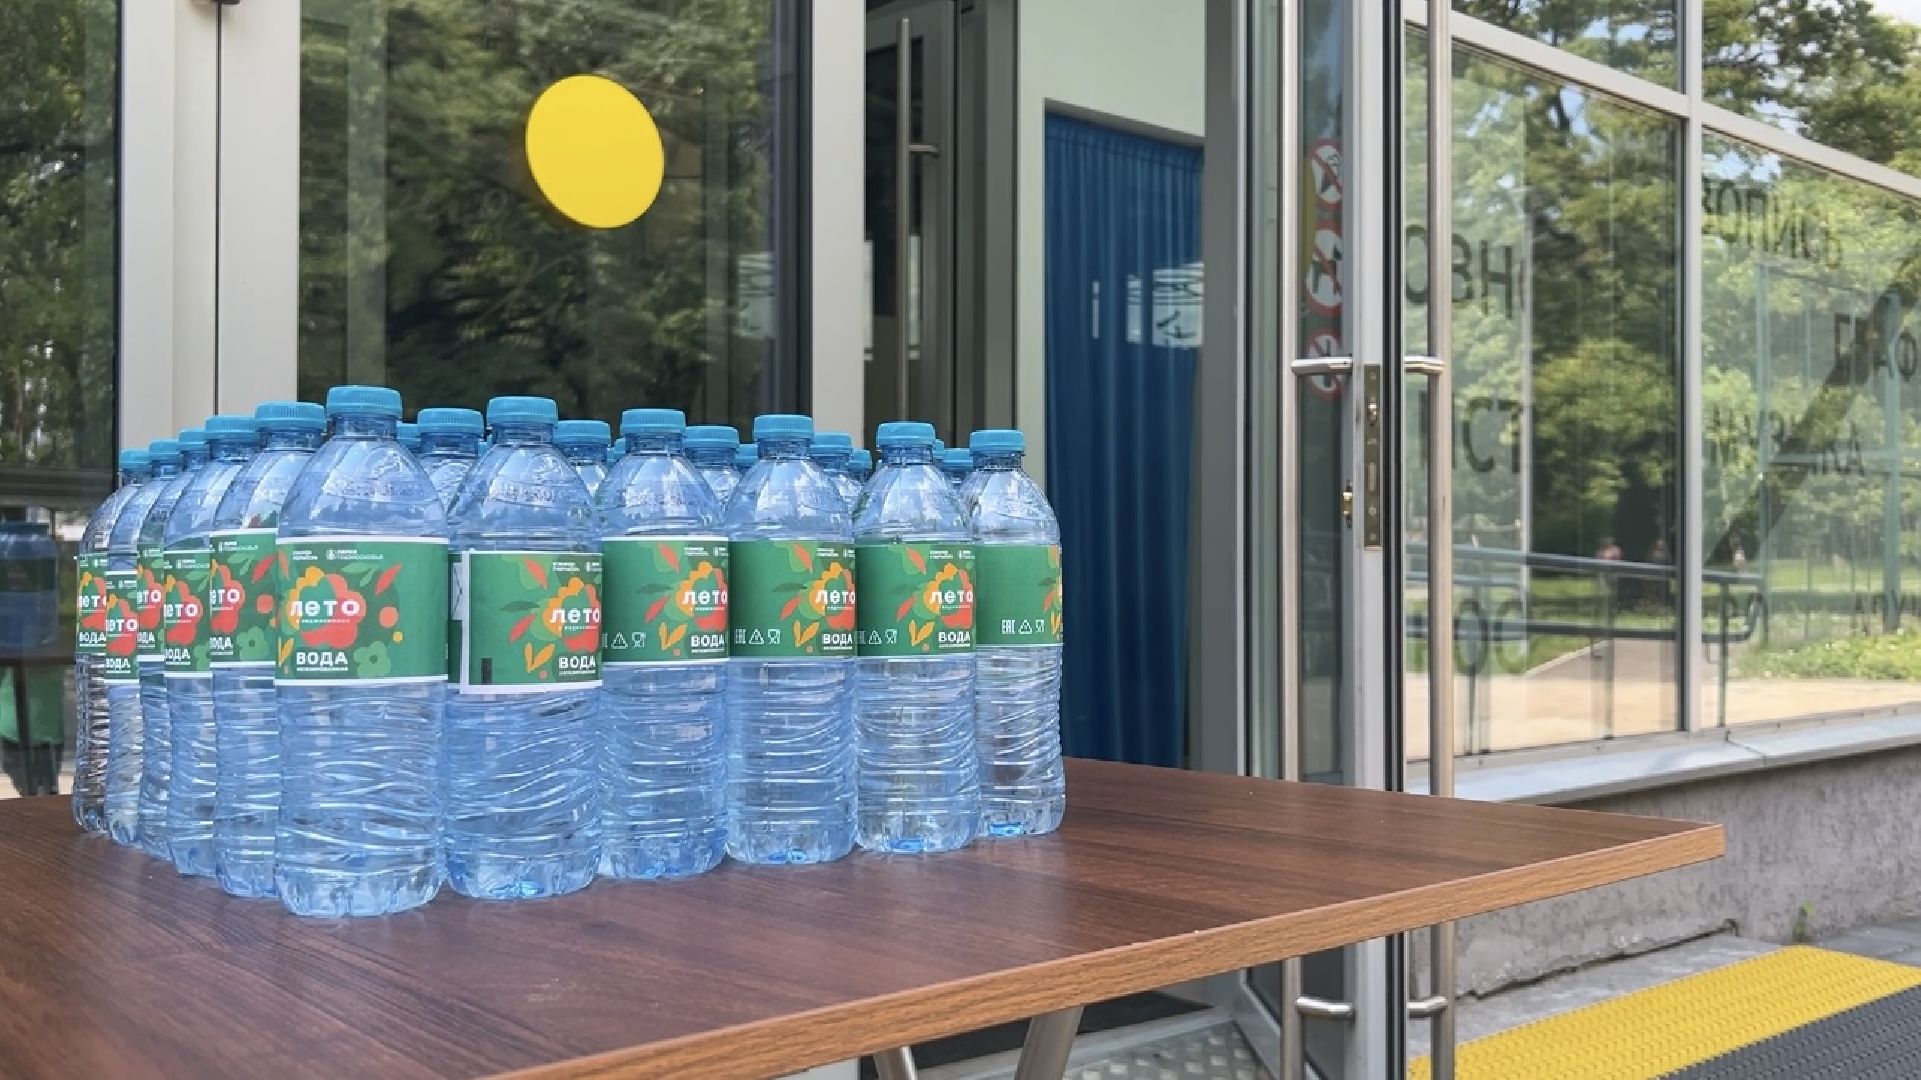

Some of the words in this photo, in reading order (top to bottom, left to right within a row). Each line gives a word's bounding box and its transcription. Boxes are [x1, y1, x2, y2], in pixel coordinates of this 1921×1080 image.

[930, 589, 974, 604] лето
[290, 598, 361, 617] лето
[690, 634, 725, 649] ВОДА
[821, 632, 853, 647] ВОДА
[938, 631, 971, 645] ВОДА
[296, 651, 348, 667] ВОДА
[558, 655, 596, 671] ВОДА
